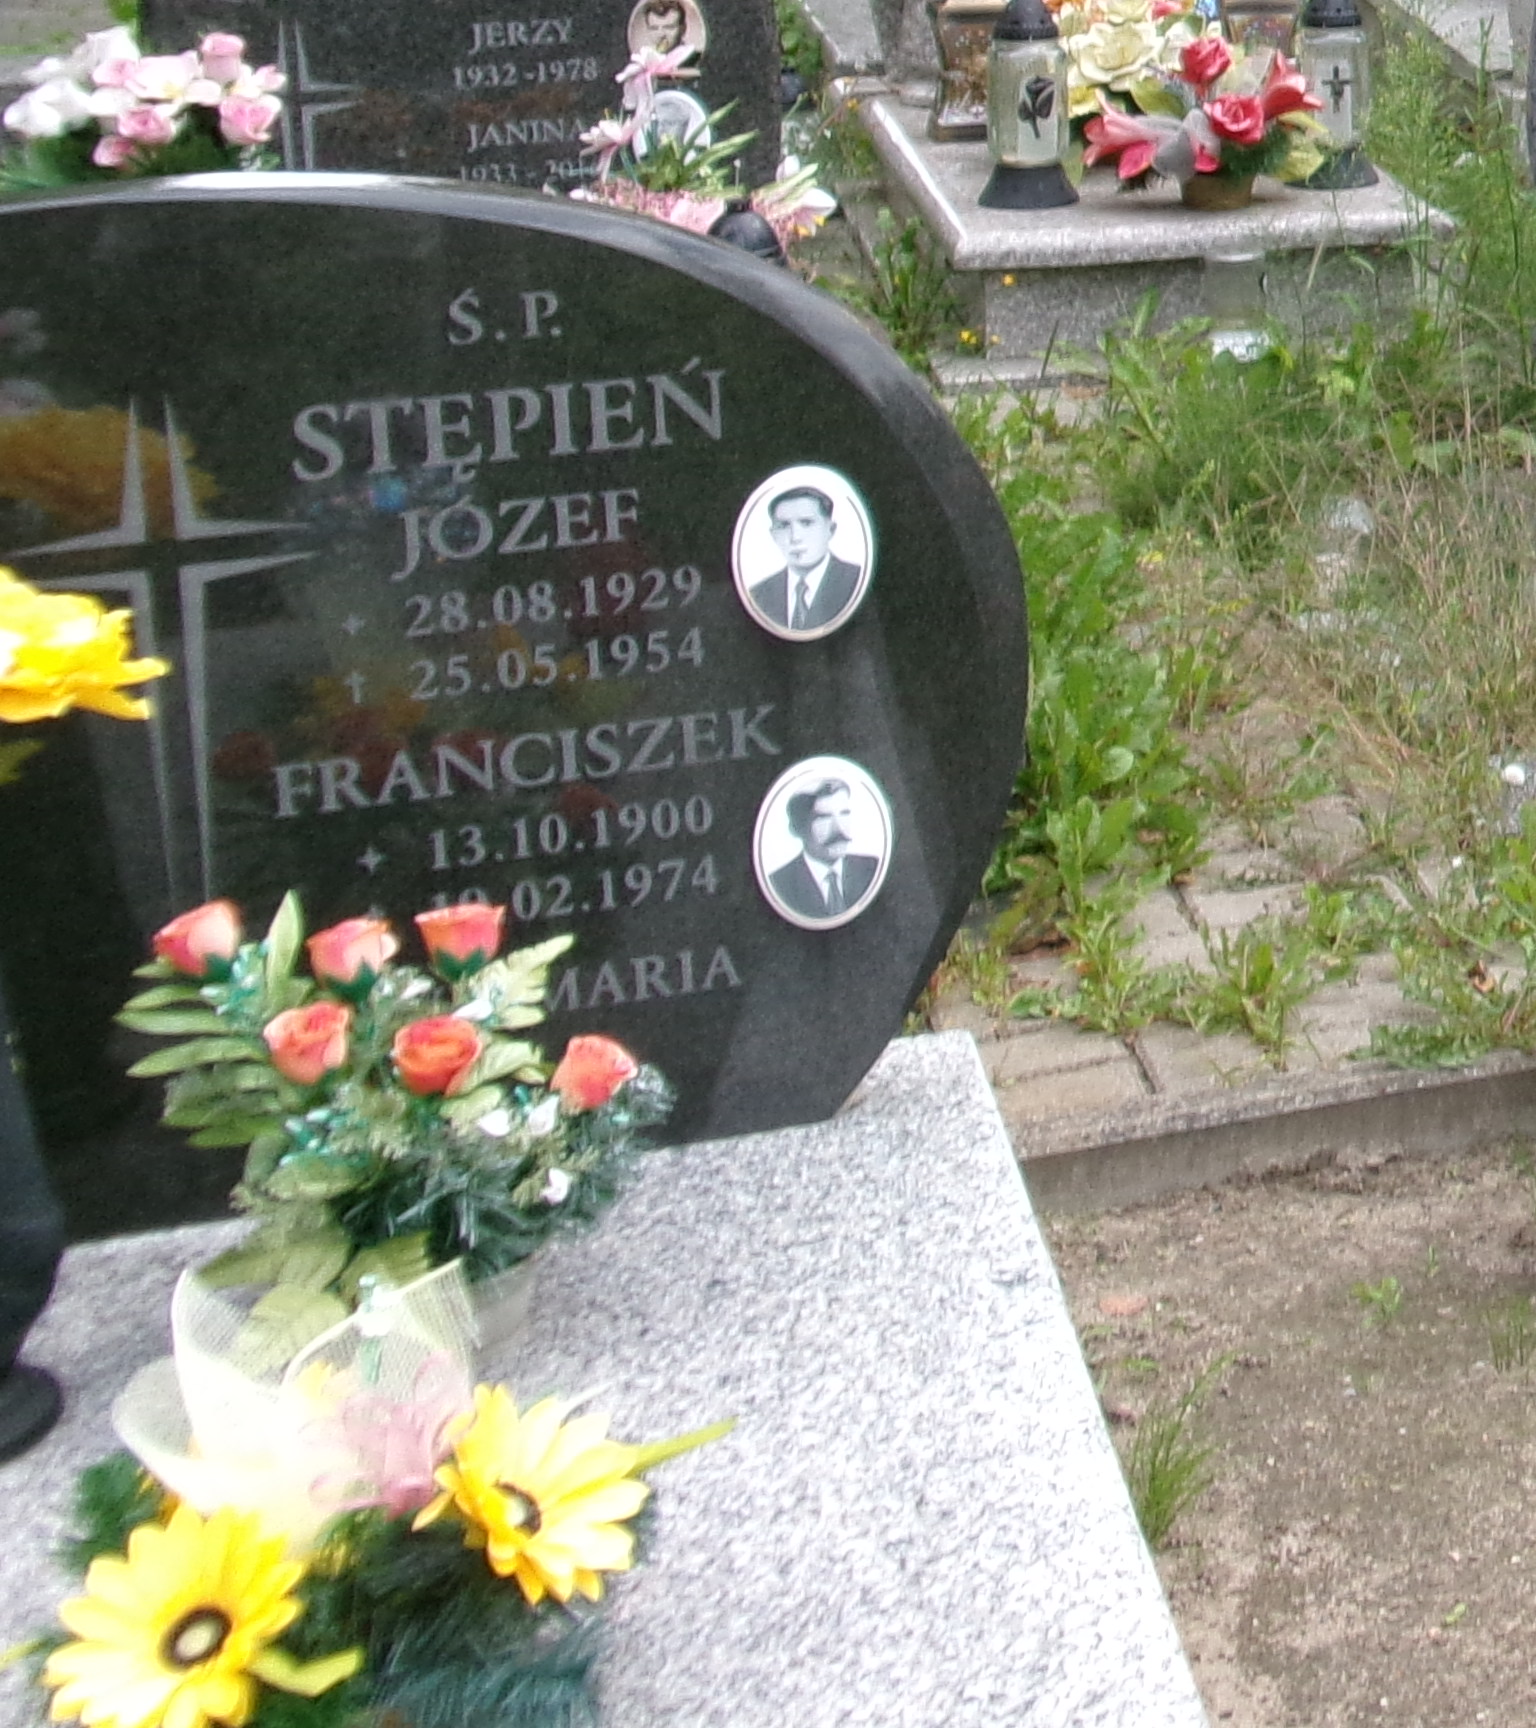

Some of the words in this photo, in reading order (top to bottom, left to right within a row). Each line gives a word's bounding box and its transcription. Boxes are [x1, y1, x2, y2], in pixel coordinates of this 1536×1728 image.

[468, 17, 573, 55] JERZY
[467, 118, 584, 153] JANINA
[292, 356, 726, 482] STĘPIEŃ
[392, 488, 640, 582] JÓZEF
[405, 564, 701, 639] 28.08.1929
[411, 627, 706, 700] 25.05.1954
[275, 704, 782, 818] FRANCISZEK
[428, 795, 714, 871] 13.10.1900
